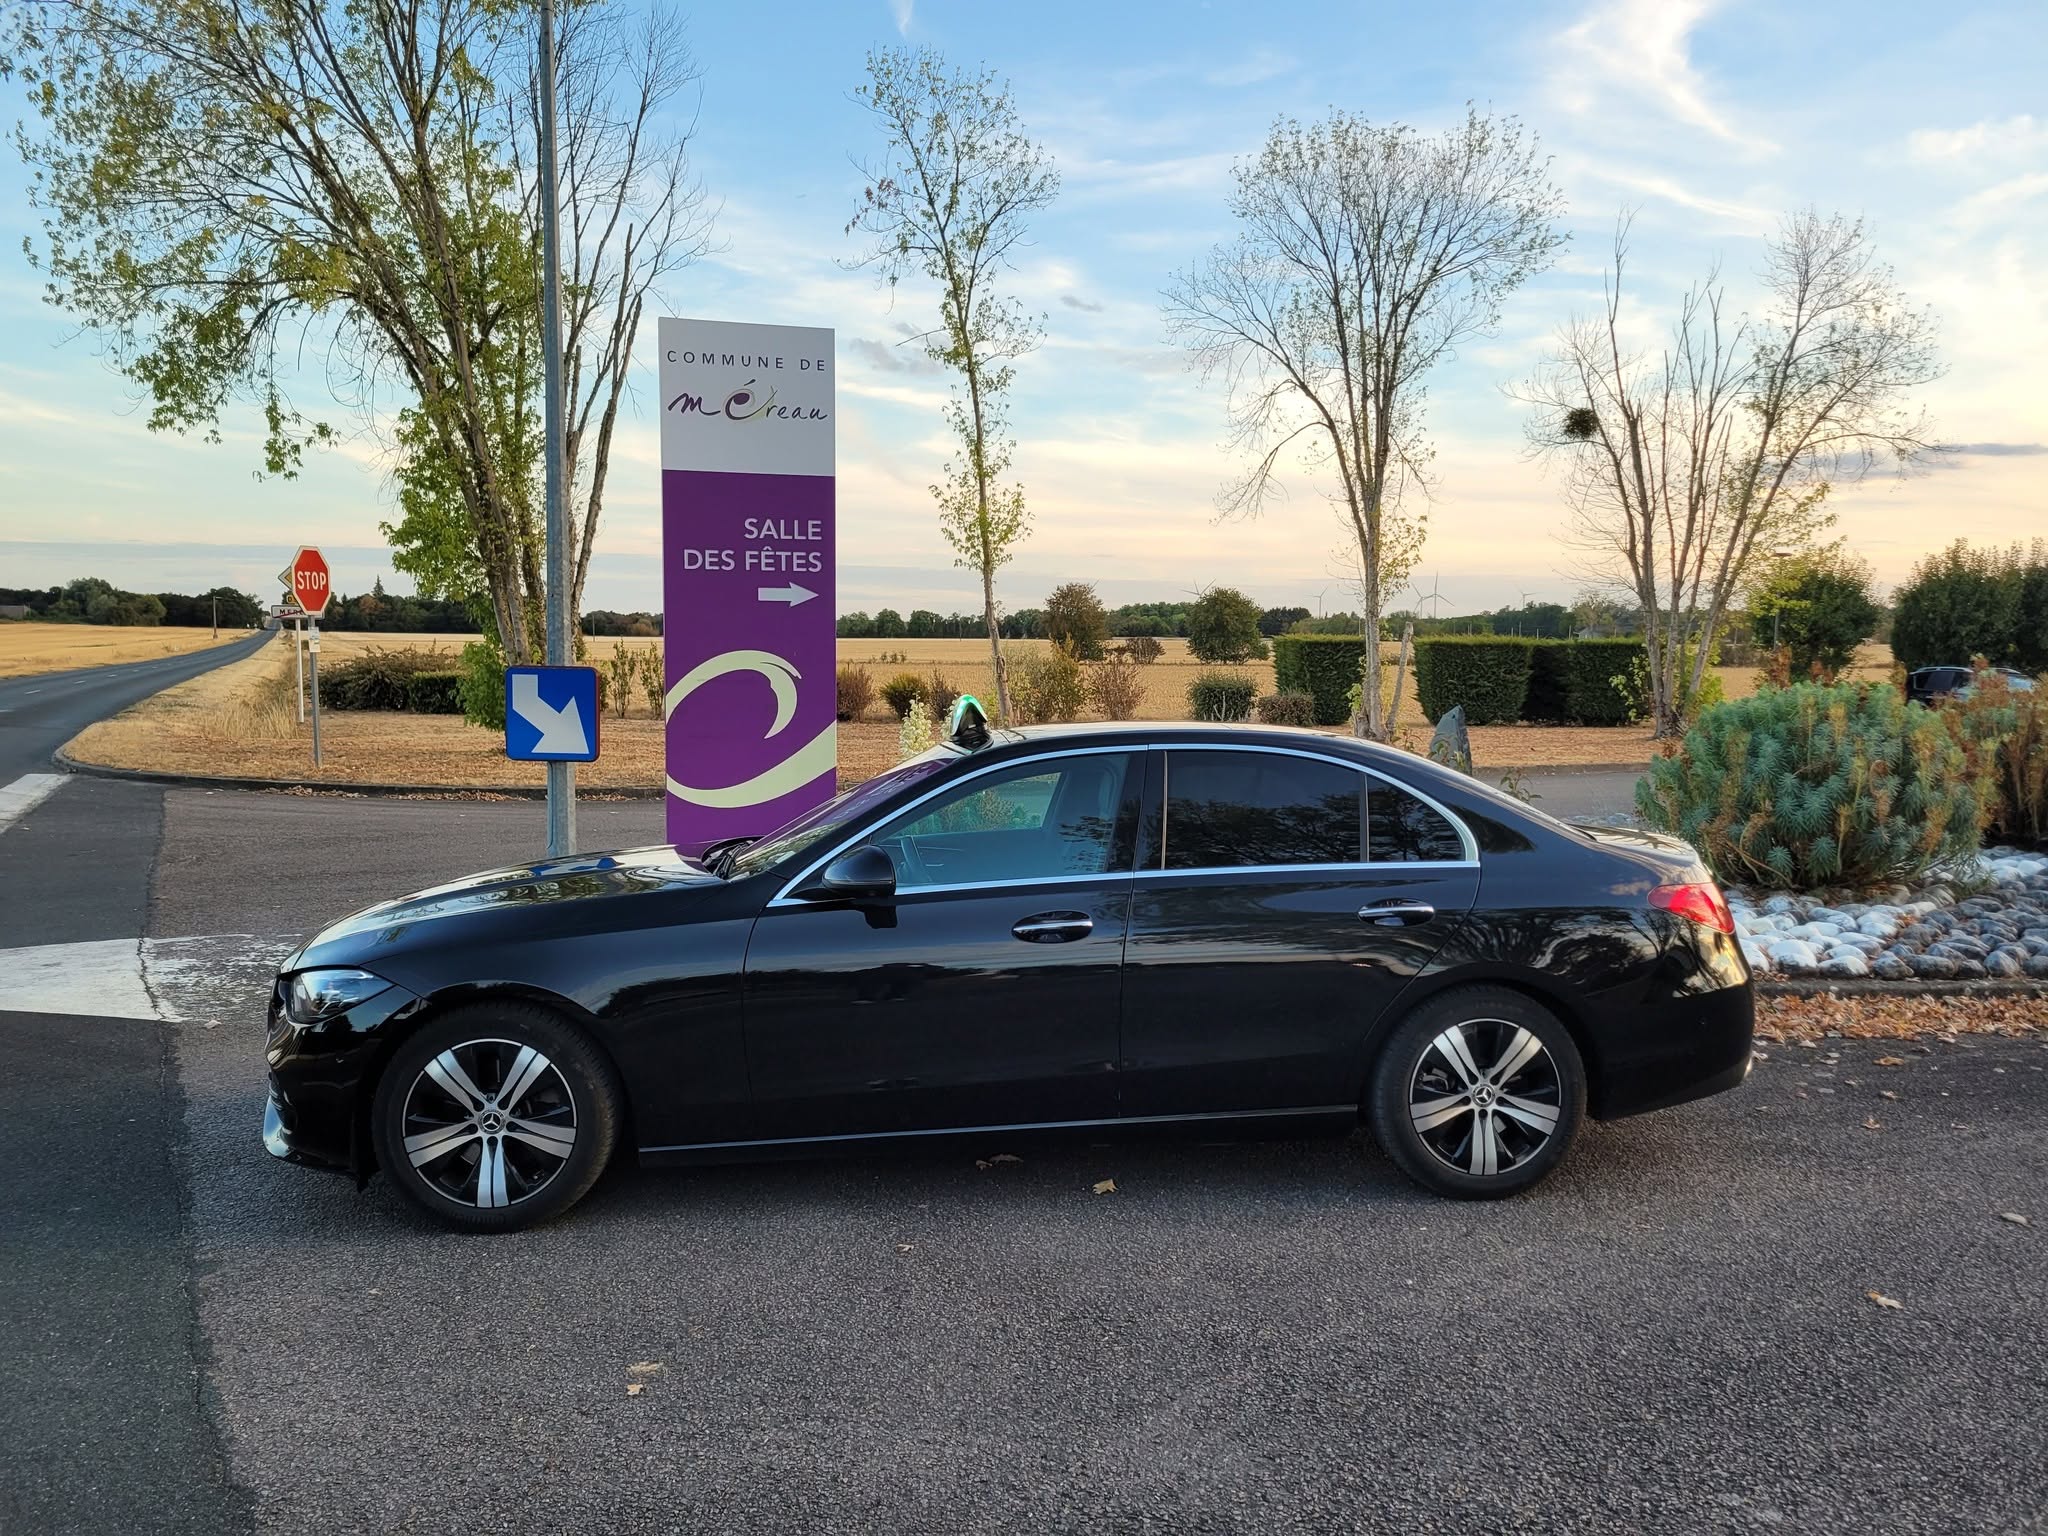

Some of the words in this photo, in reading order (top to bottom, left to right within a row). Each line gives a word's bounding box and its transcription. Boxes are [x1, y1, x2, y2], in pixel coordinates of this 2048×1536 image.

[667, 350, 784, 369] COMMUNE
[800, 359, 825, 371] DE
[744, 517, 822, 540] SALLE
[683, 549, 735, 571] DES
[745, 547, 822, 572] FÊTES
[297, 571, 326, 590] STOP
